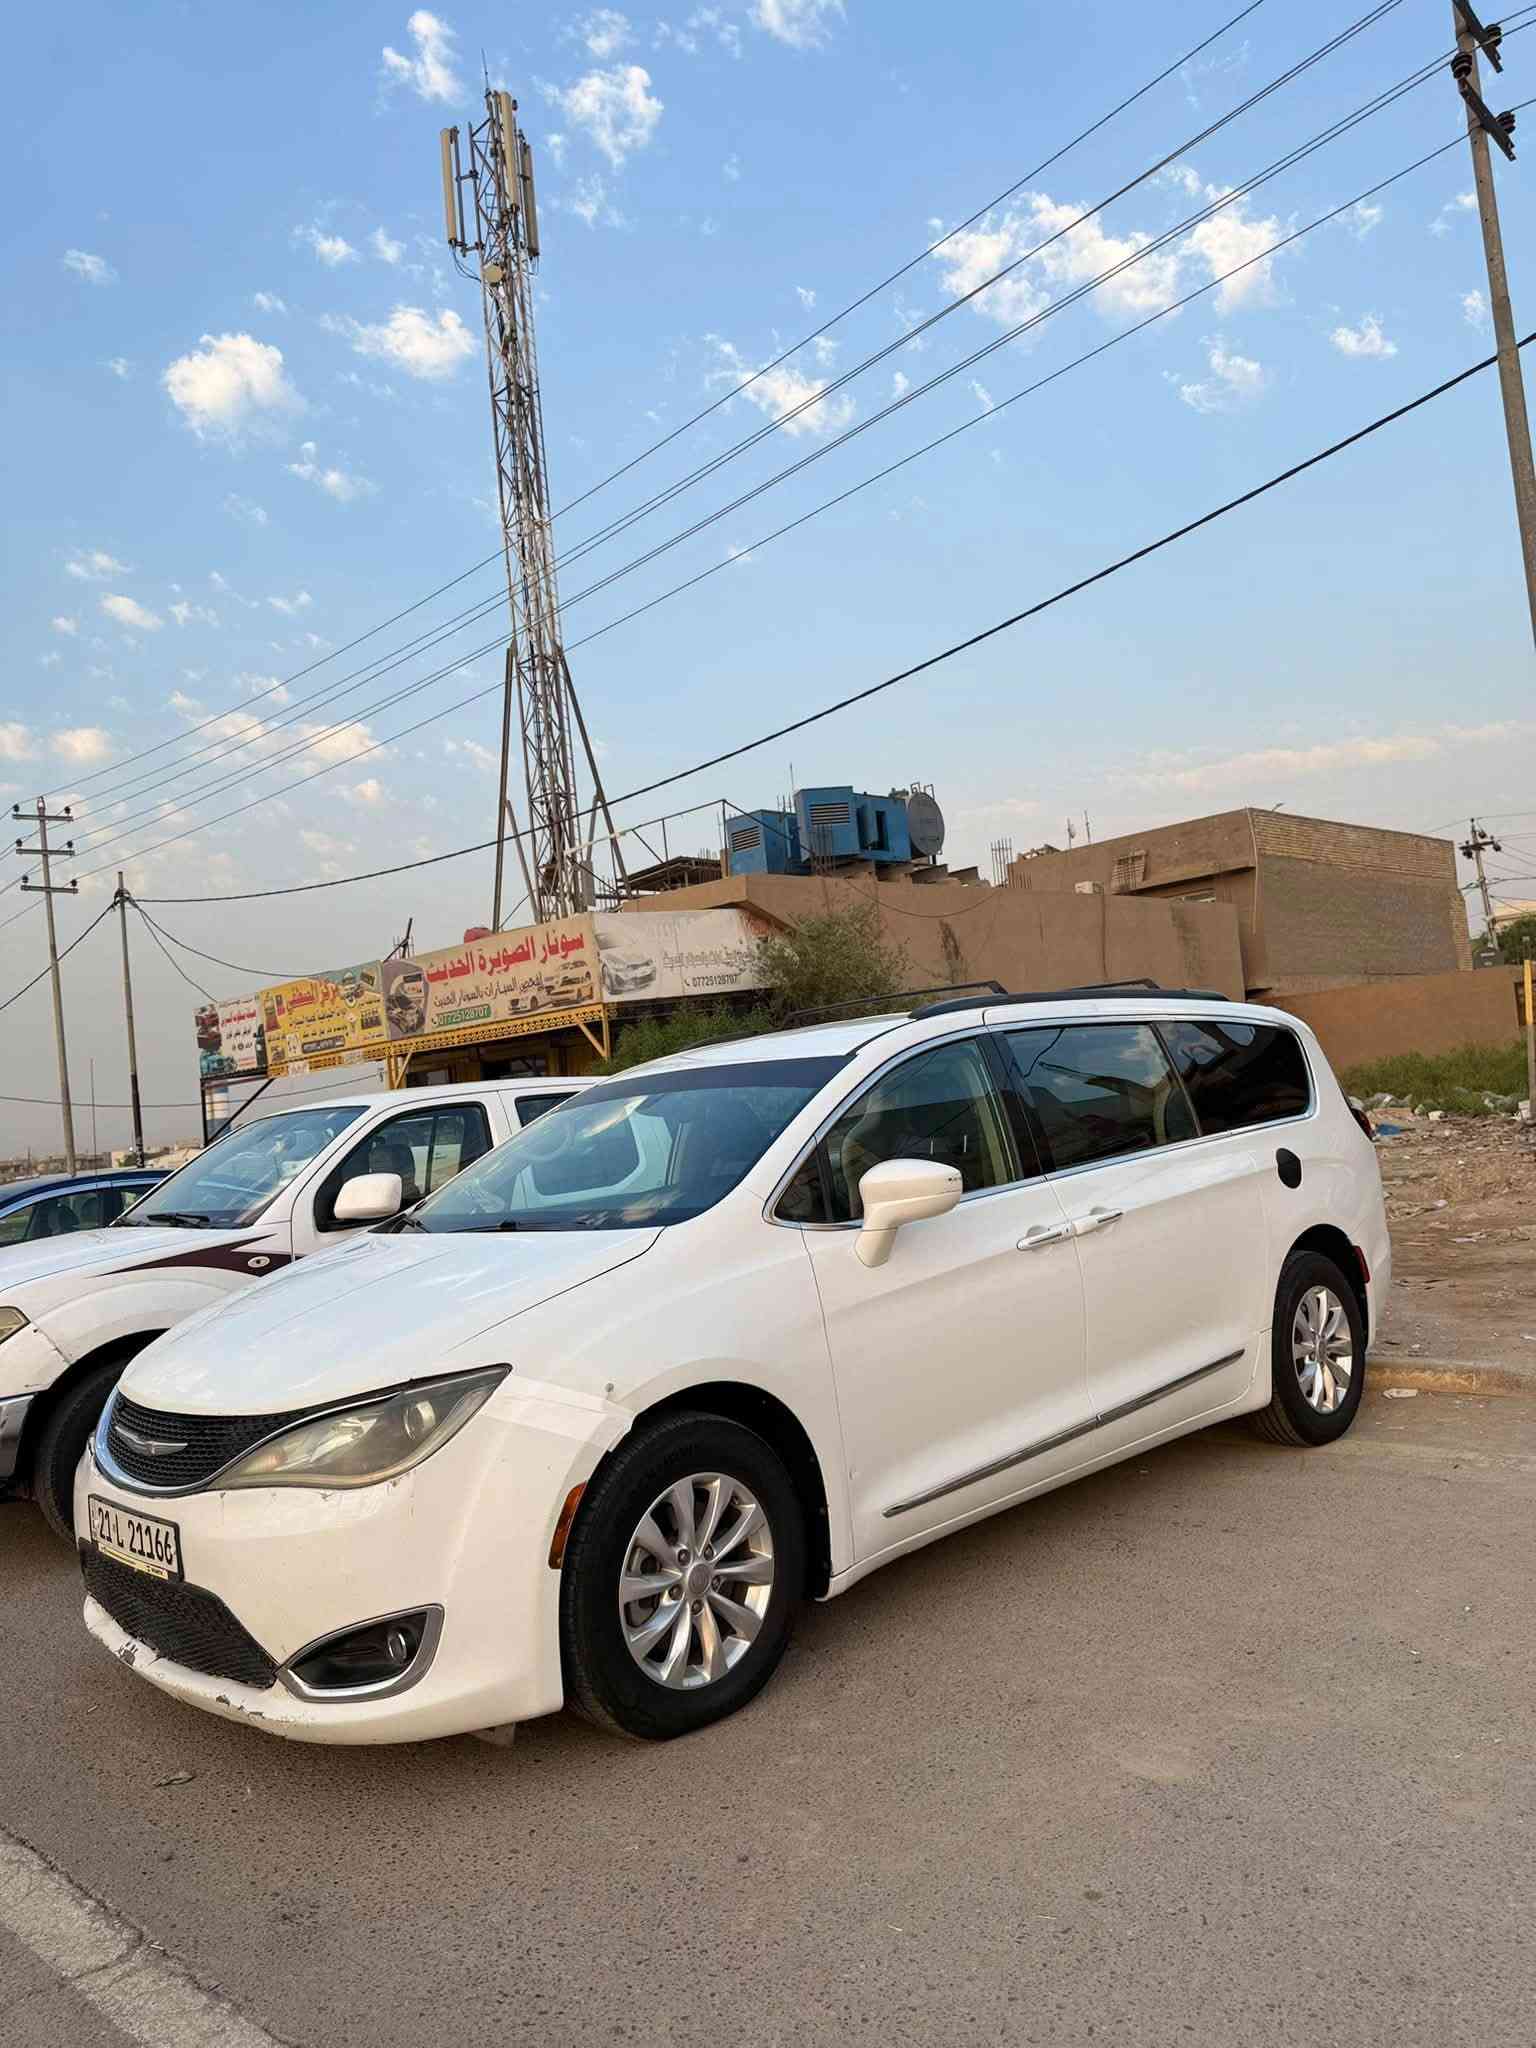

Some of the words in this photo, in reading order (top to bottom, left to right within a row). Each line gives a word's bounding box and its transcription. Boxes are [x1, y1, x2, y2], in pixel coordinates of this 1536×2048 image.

[478, 935, 536, 976] الصويرة
[540, 929, 585, 964] سونار
[425, 950, 475, 986] الحديث
[98, 1507, 112, 1543] 21
[128, 1519, 173, 1565] 21166
